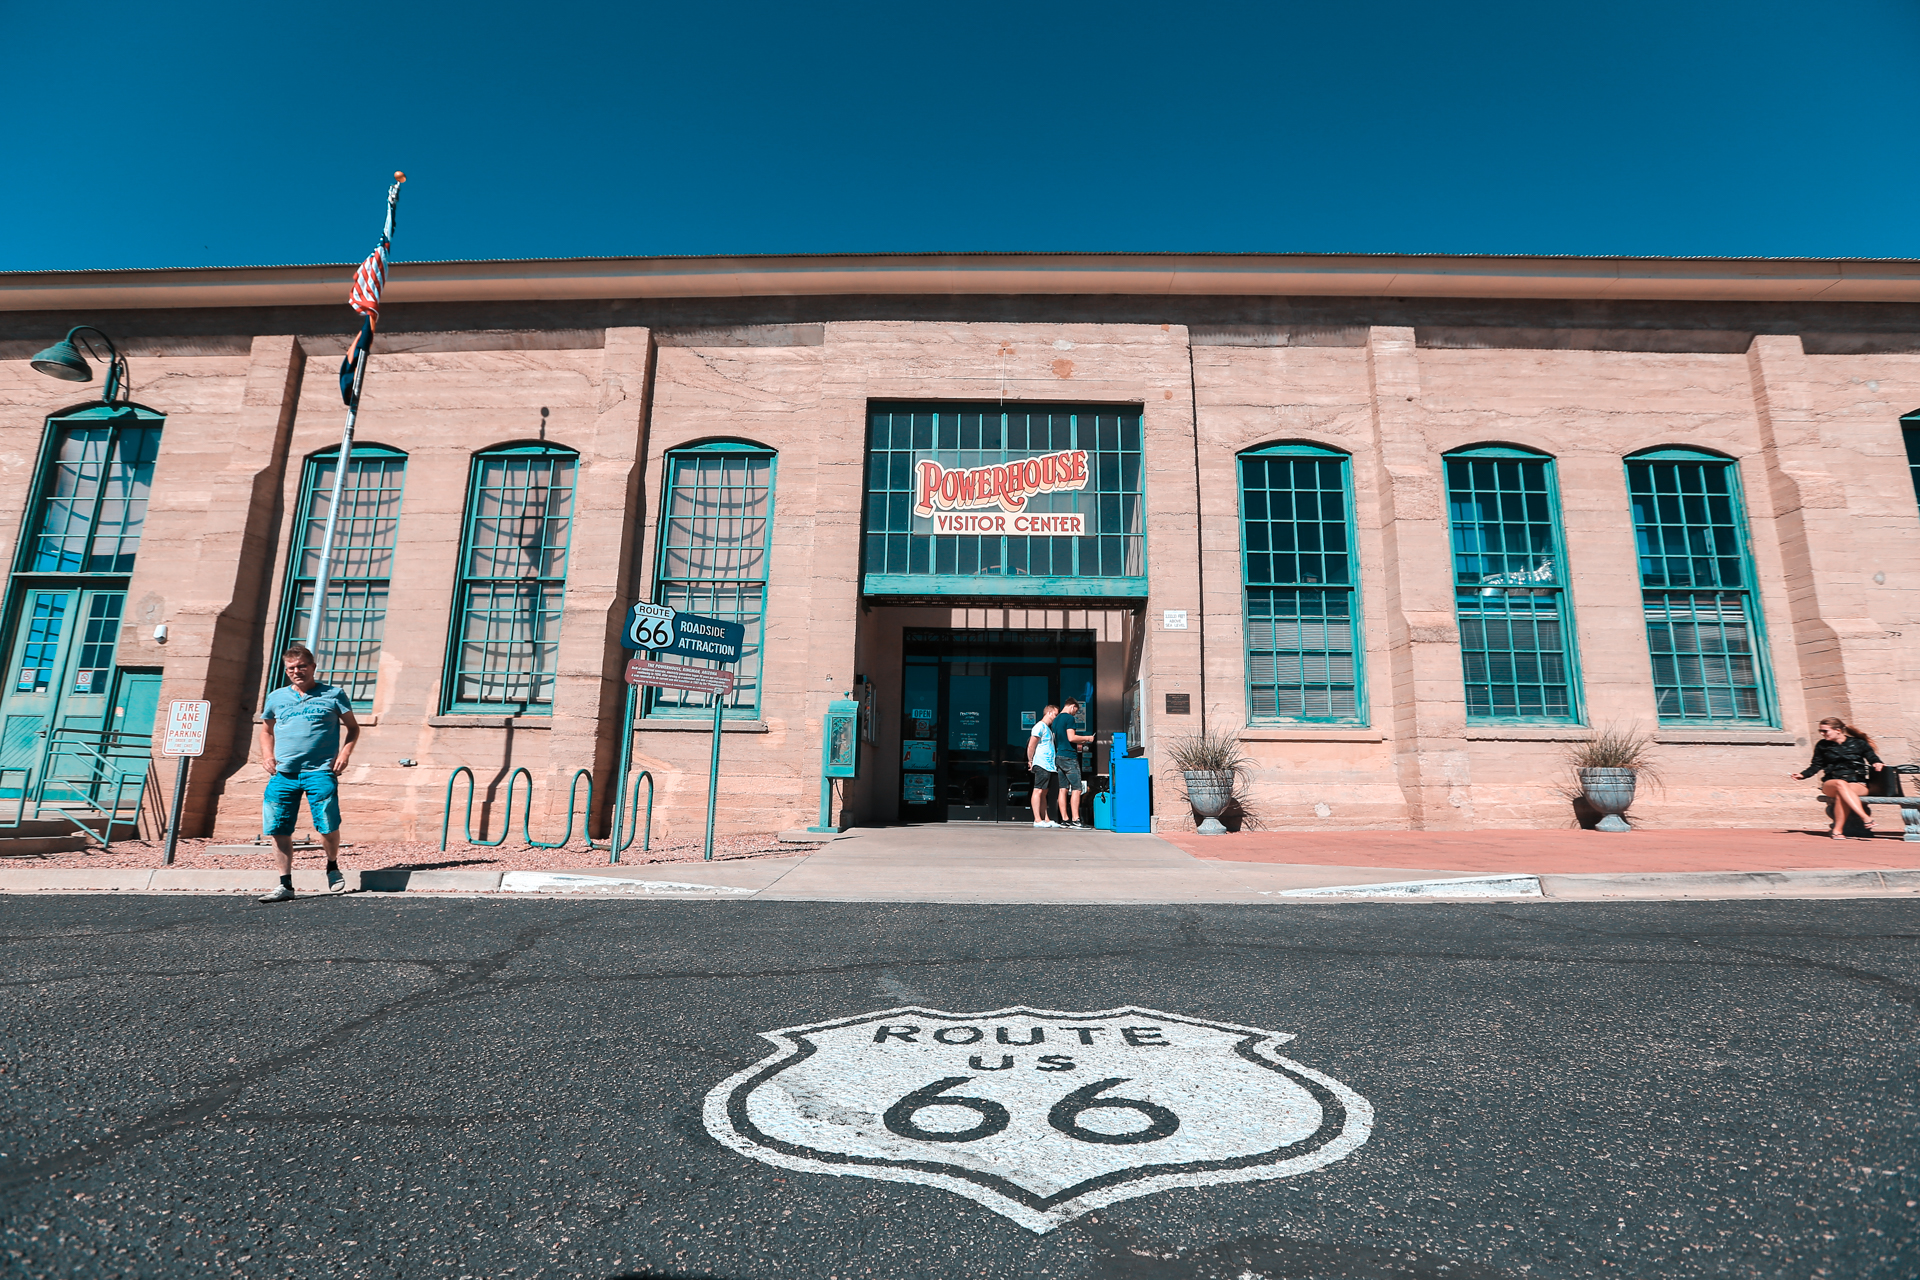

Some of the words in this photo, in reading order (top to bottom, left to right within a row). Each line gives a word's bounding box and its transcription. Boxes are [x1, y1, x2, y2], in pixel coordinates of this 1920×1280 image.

[916, 451, 1087, 515] POWERHOUSE
[937, 515, 1006, 531] VISITOR
[1014, 516, 1081, 532] CENTER
[639, 605, 670, 618] ROUTE
[636, 617, 668, 646] 66
[680, 620, 726, 639] ROADSIDE
[678, 637, 735, 656] ATTRACTION
[179, 702, 200, 712] FIRE
[914, 709, 931, 718] OPEN
[176, 712, 200, 721] LANE
[169, 730, 202, 738] PARKING
[181, 722, 192, 730] NO
[872, 1025, 1172, 1046] ROUTE
[968, 1054, 1077, 1072] US
[883, 1076, 1181, 1145] 66
